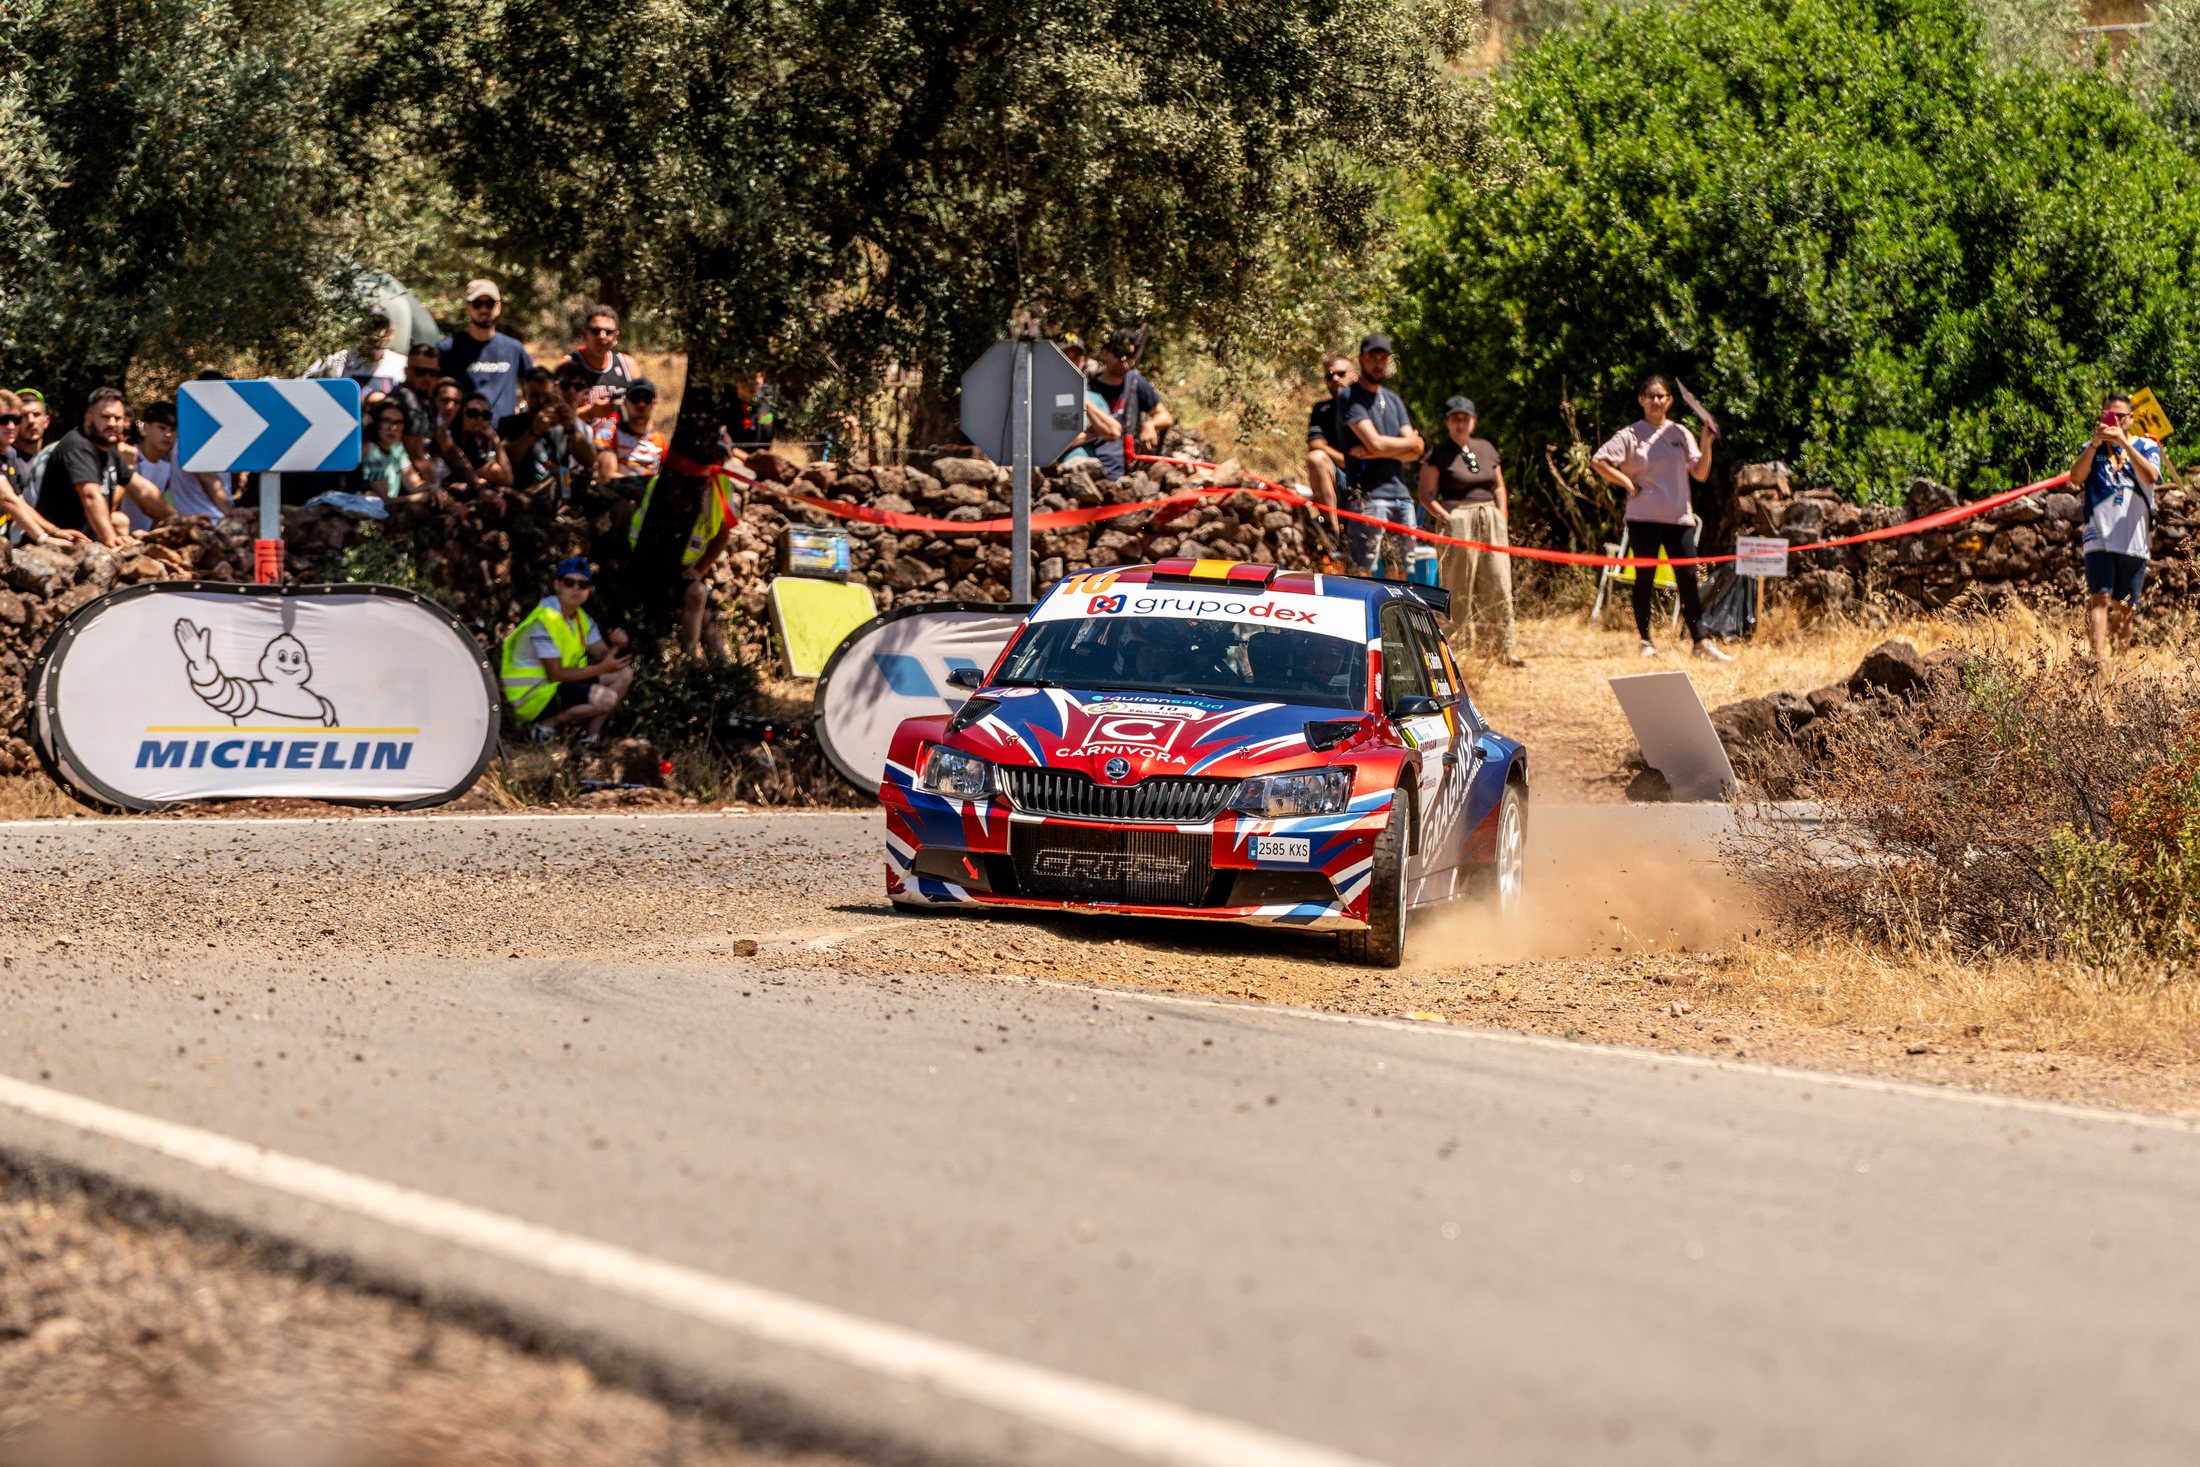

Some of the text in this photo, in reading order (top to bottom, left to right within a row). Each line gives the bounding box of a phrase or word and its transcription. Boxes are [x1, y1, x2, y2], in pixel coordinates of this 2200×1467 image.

[1062, 572, 1121, 595] 10
[1133, 598, 1319, 625] grupodex
[1101, 718, 1166, 741] C
[135, 740, 414, 770] MICHELIN
[1055, 745, 1187, 765] CARNIVORA
[1258, 842, 1309, 857] 2585 KXS
